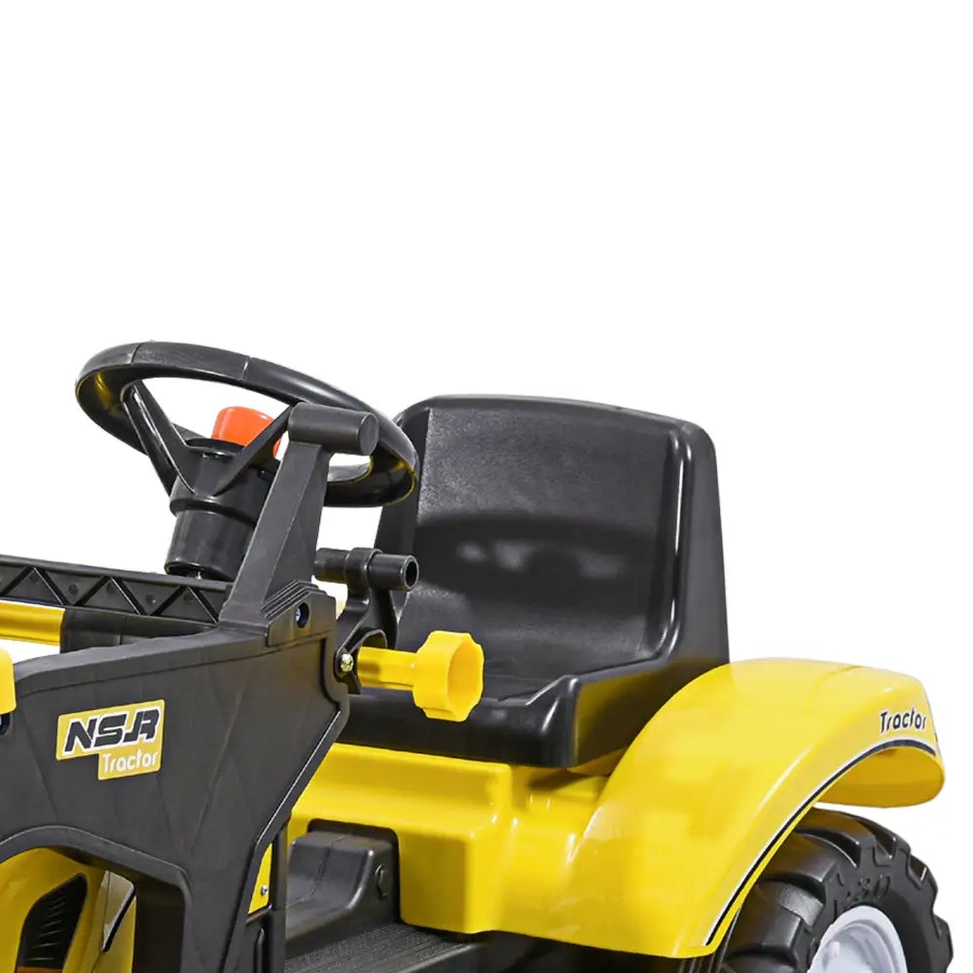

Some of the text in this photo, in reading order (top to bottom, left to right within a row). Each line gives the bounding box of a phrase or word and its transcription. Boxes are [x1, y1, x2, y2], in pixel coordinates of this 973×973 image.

[63, 708, 160, 753] NSR
[880, 706, 926, 734] Tractor
[102, 749, 158, 774] Tractor
